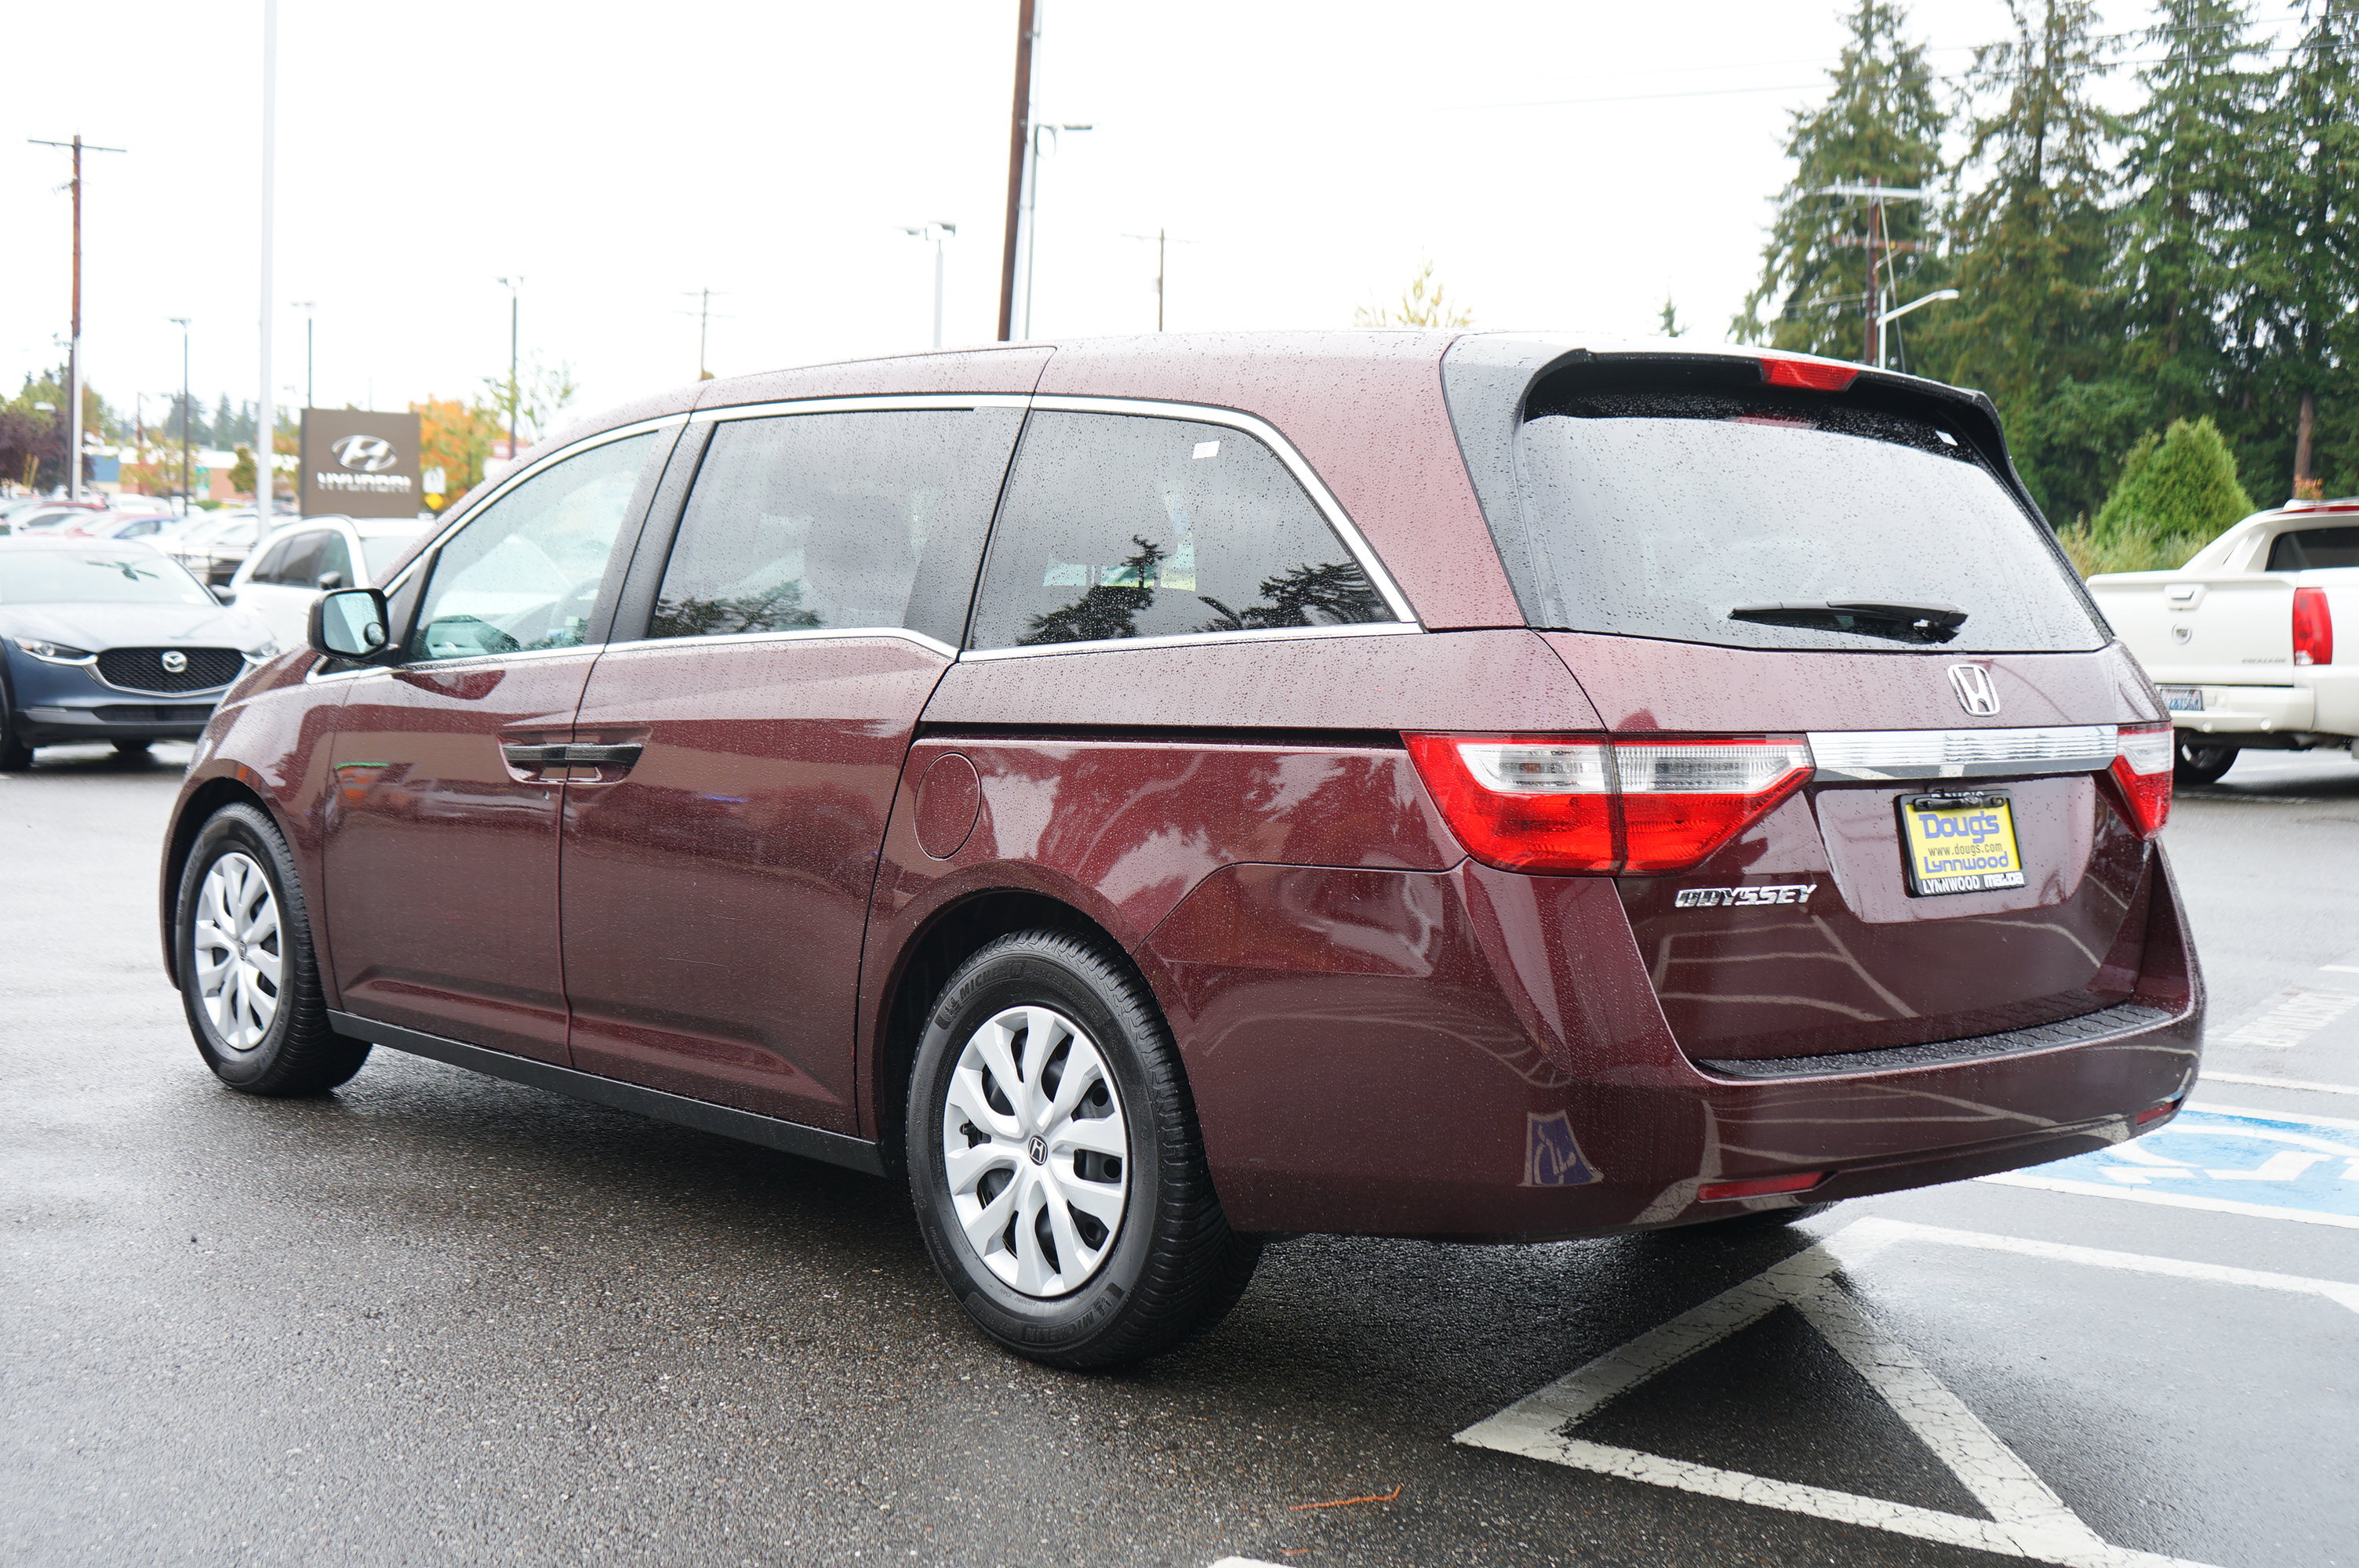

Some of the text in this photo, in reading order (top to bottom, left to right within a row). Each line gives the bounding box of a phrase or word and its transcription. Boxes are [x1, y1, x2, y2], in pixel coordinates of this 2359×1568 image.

[1928, 844, 2003, 856] www.dougs.com
[1923, 851, 2008, 873] Lynnwood
[1922, 876, 1980, 894] LYNNWOOD
[1674, 884, 1817, 907] ODYSSEY
